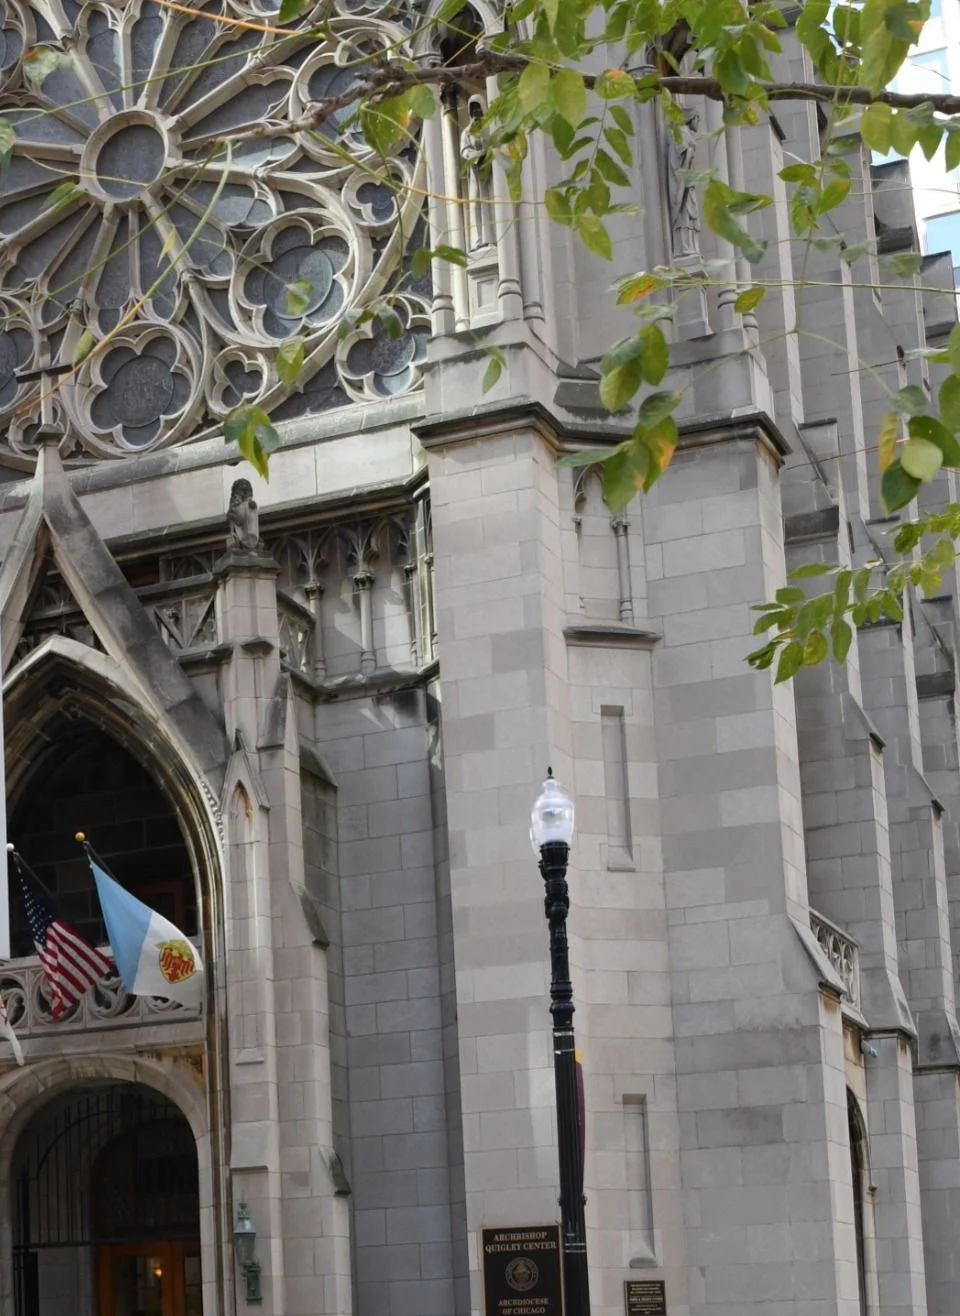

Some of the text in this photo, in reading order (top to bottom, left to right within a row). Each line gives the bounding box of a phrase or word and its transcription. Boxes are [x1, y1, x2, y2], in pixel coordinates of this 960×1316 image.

[493, 1232, 548, 1242] ARCHBISHOP
[485, 1241, 557, 1253] QUIGLEY CENTER
[513, 1306, 546, 1315] CHICAGO
